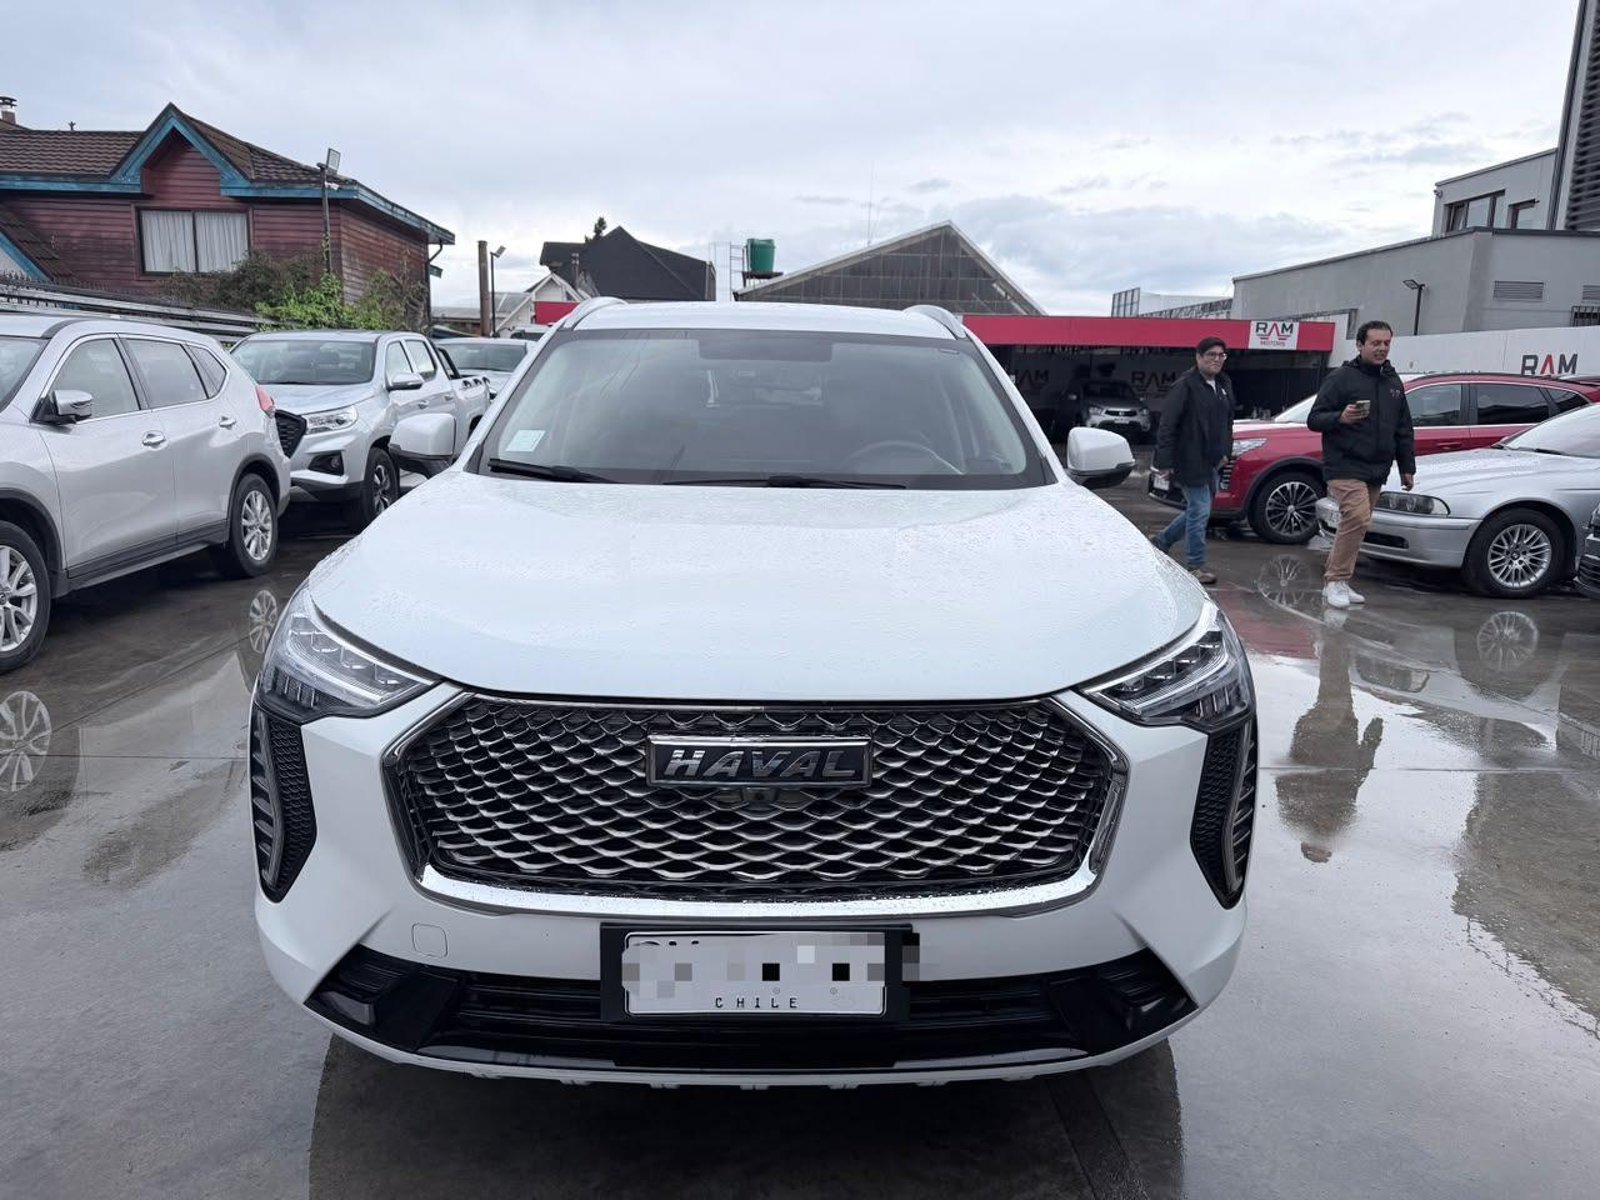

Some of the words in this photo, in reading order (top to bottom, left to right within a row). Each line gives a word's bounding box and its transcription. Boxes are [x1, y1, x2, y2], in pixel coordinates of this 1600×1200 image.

[1256, 322, 1294, 336] RAM
[1521, 354, 1578, 375] RAM
[1132, 371, 1176, 388] RAM
[664, 750, 856, 777] HAVAL
[715, 997, 798, 1008] CHILE
